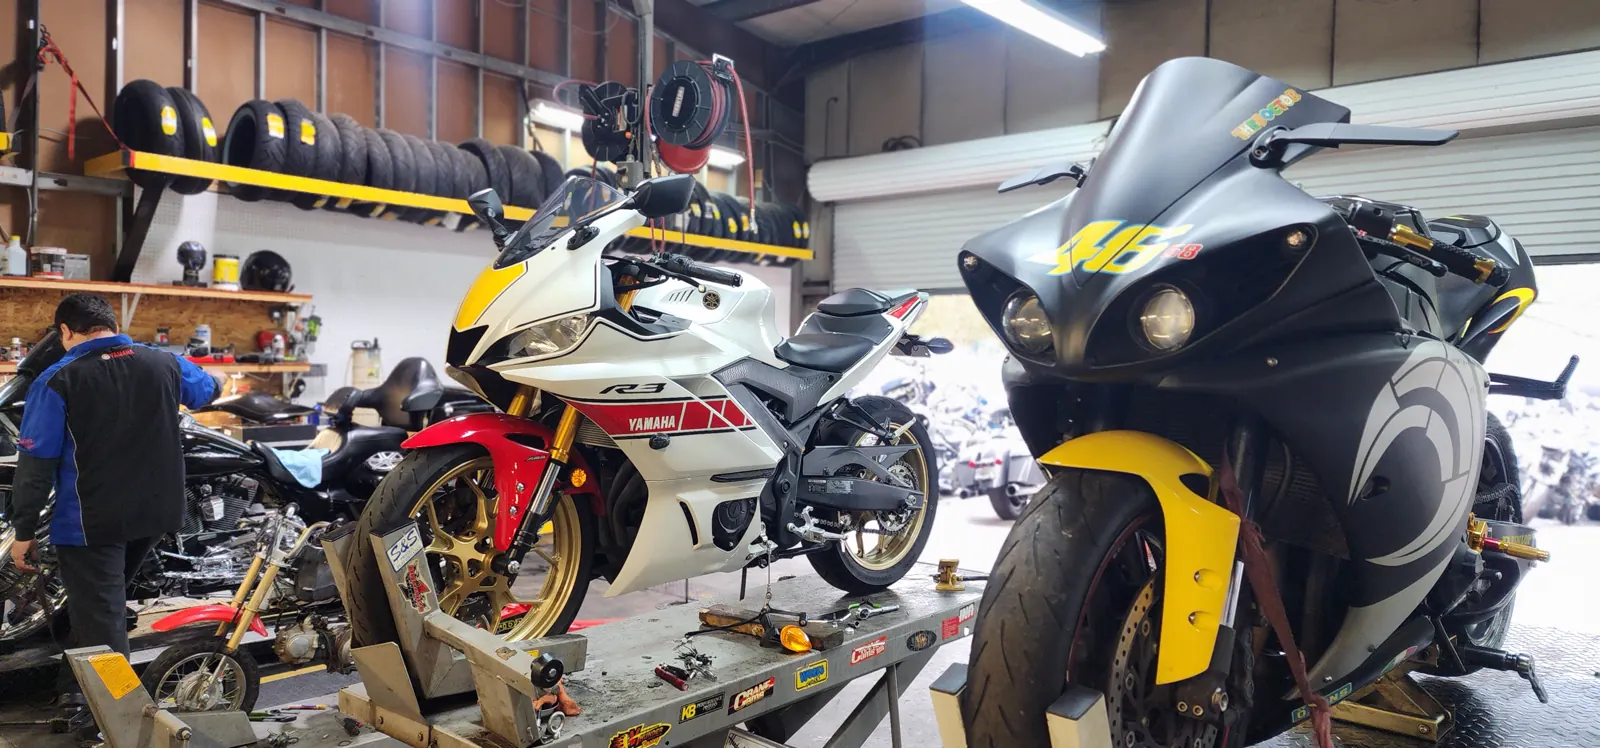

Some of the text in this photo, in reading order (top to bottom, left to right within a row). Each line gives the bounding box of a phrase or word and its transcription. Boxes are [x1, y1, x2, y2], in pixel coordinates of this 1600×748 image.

[1024, 220, 1194, 276] 46
[599, 383, 667, 394] R3
[628, 415, 676, 431] YAMAHA
[390, 529, 418, 563] S&S
[681, 703, 697, 721] KB
